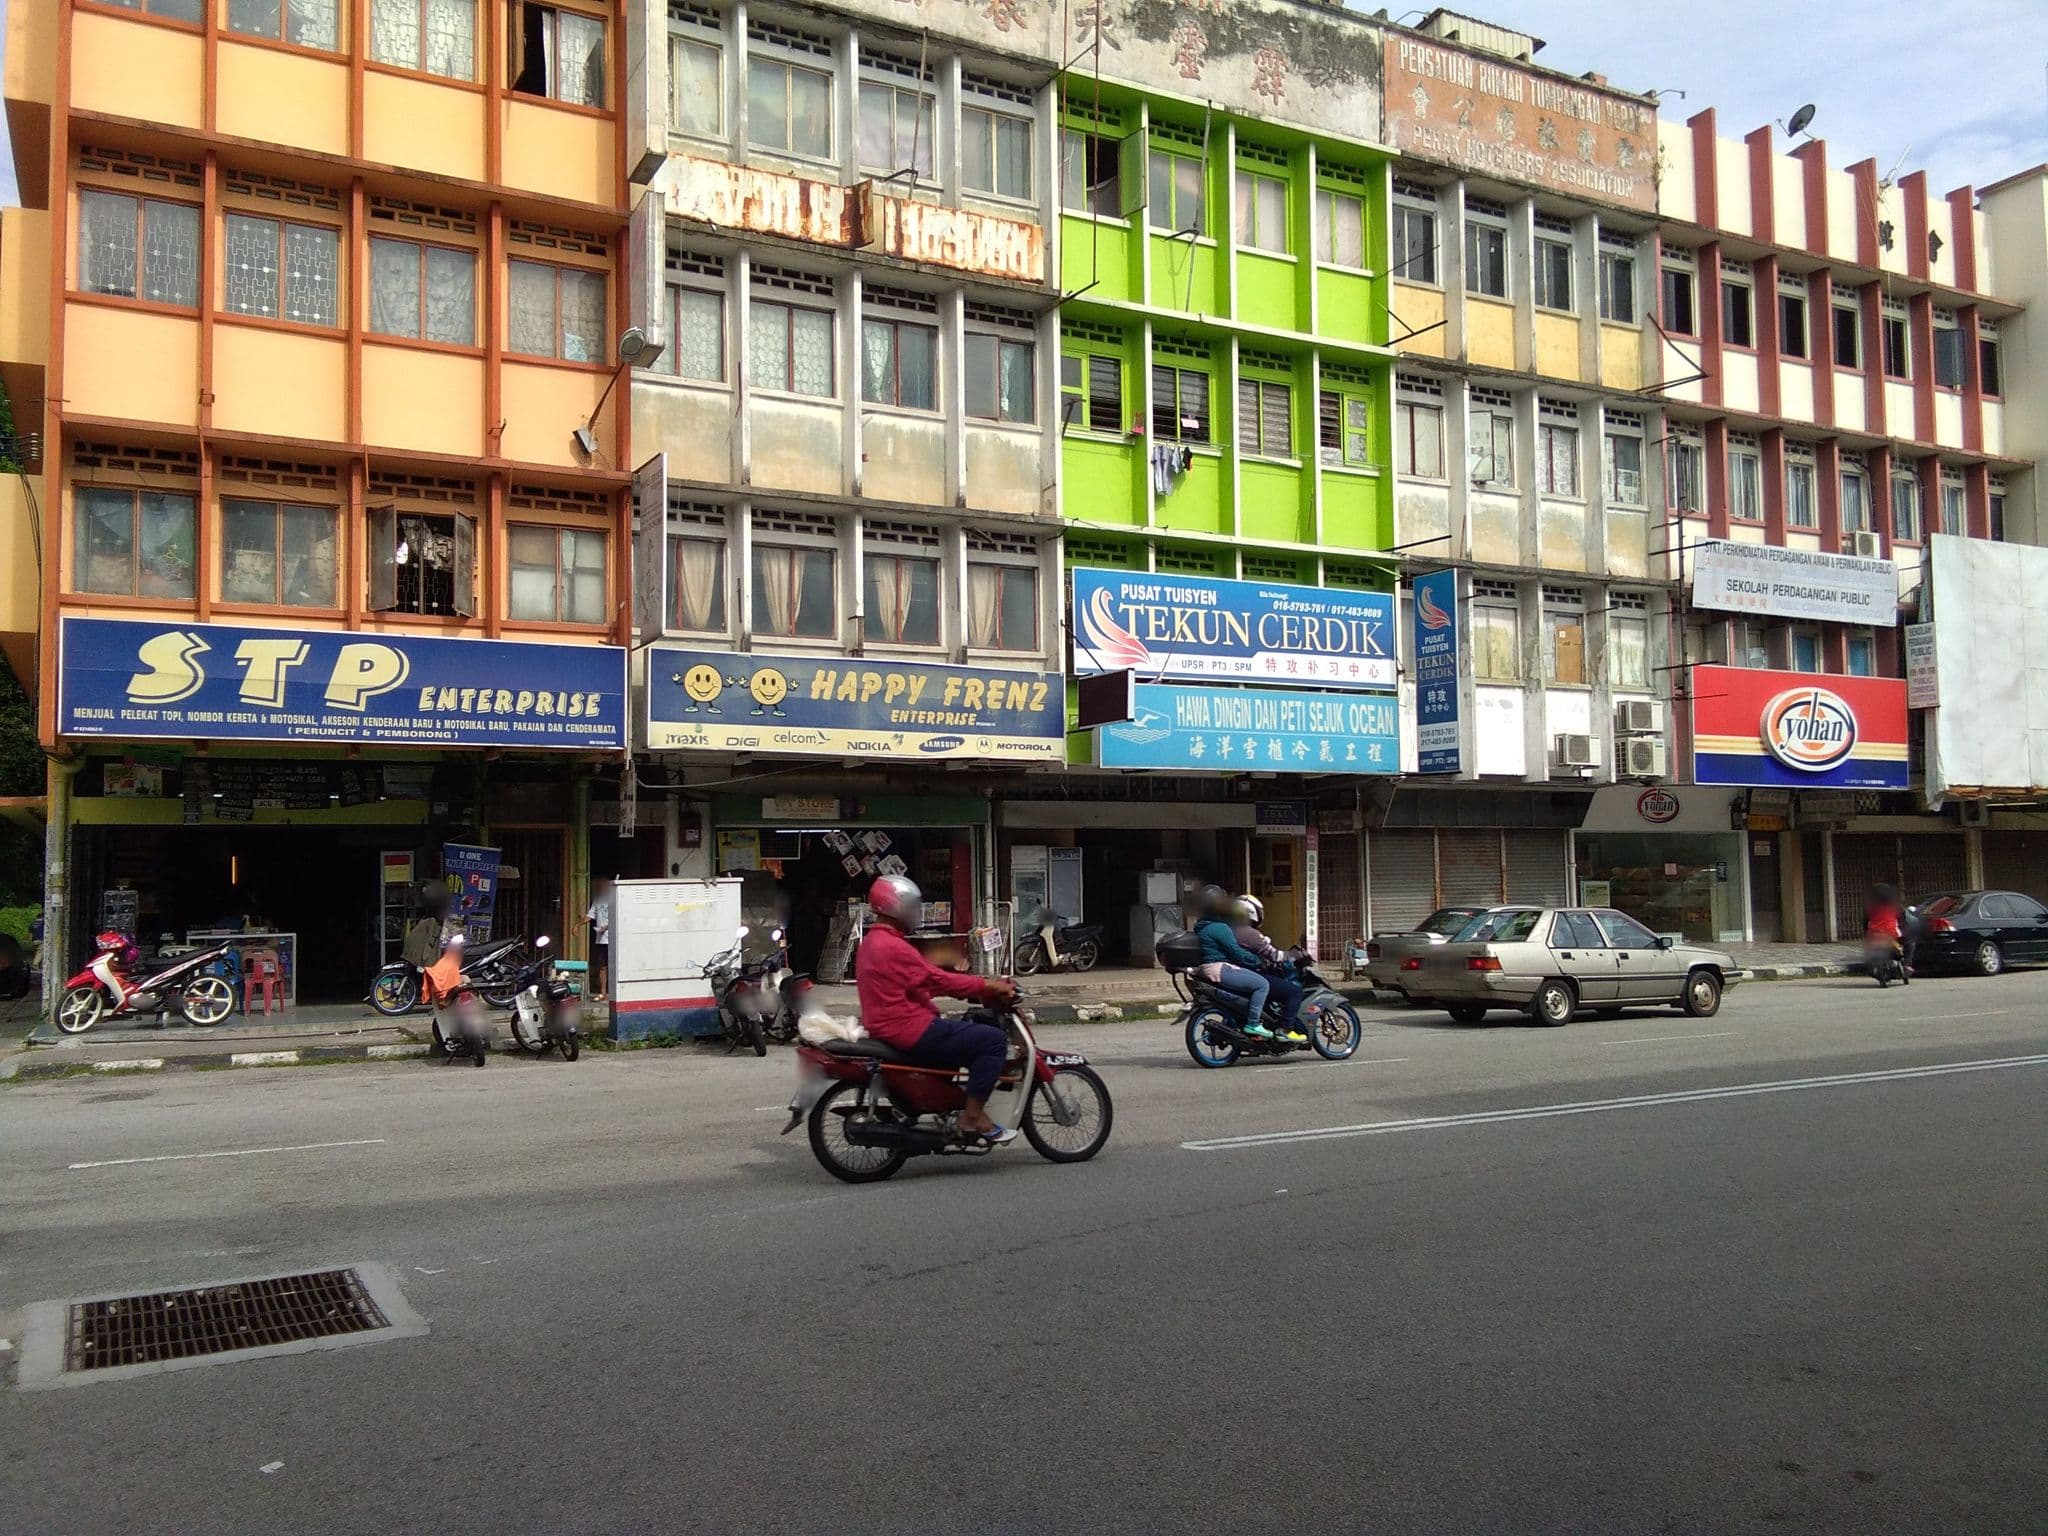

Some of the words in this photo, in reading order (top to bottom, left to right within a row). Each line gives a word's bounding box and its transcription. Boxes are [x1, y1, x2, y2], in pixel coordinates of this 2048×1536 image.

[1400, 40, 1473, 89] PERSATUAN
[1480, 63, 1523, 103] RUMAH
[1529, 79, 1600, 125] TUMPANGAN
[1413, 125, 1460, 156] PERAK
[1551, 160, 1634, 199] ASSOCIATION
[1872, 561, 1892, 575] PUBLIC
[1121, 583, 1162, 601] PUSAT
[1164, 586, 1217, 605] TUISYEN
[1726, 579, 1769, 595] SEKOLAH
[1773, 584, 1837, 602] PERDAGANGAN
[1840, 591, 1870, 606] PUBLIC
[1118, 602, 1251, 648] TEKUN
[1258, 612, 1386, 656] CERDIK
[1424, 633, 1446, 645] PUSAT
[126, 631, 410, 712] STP
[1181, 659, 1204, 670] UPSR
[1212, 661, 1228, 671] PT3
[1234, 662, 1252, 672] SPM
[1265, 656, 1380, 679] 特攻补习中心
[1417, 653, 1456, 670] TEKUN
[1419, 668, 1455, 682] CERDIK
[418, 686, 602, 717] ENTERPRISE
[811, 669, 927, 705] HAPPY
[943, 676, 1049, 712] FRENZ
[73, 708, 115, 720] MENJUAL
[121, 710, 158, 721] PELEKAT
[162, 711, 184, 723] TOPI,
[187, 711, 223, 723] NOMBOR
[226, 713, 257, 724] KERETA
[270, 714, 319, 726] MOTOSIKAL,
[321, 715, 360, 726] AKSESORI
[363, 717, 409, 728] KENDERAAN
[412, 718, 433, 729] BARU
[444, 720, 486, 730] MOTOSIKAL
[488, 721, 510, 732] BARU,
[513, 722, 545, 733] PAKAIAN
[548, 722, 563, 733] DAN
[566, 723, 617, 734] CENDERAMATA
[890, 709, 977, 727] ENTERPRISE
[1176, 695, 1211, 728] HAWA
[1213, 696, 1251, 730] DINGIN
[1254, 699, 1278, 731] DAN
[1280, 700, 1306, 732] PETI
[1309, 701, 1345, 733] SEJUK
[1350, 703, 1394, 735] OCEAN
[1781, 691, 1844, 750] yohan
[362, 729, 371, 737] &
[666, 733, 709, 745] maxis
[773, 730, 818, 744] celcom
[847, 741, 891, 751] NOKIA
[923, 738, 961, 750] SAMSUNG
[996, 742, 1052, 752] MOTOROLA
[466, 851, 482, 861] ONE
